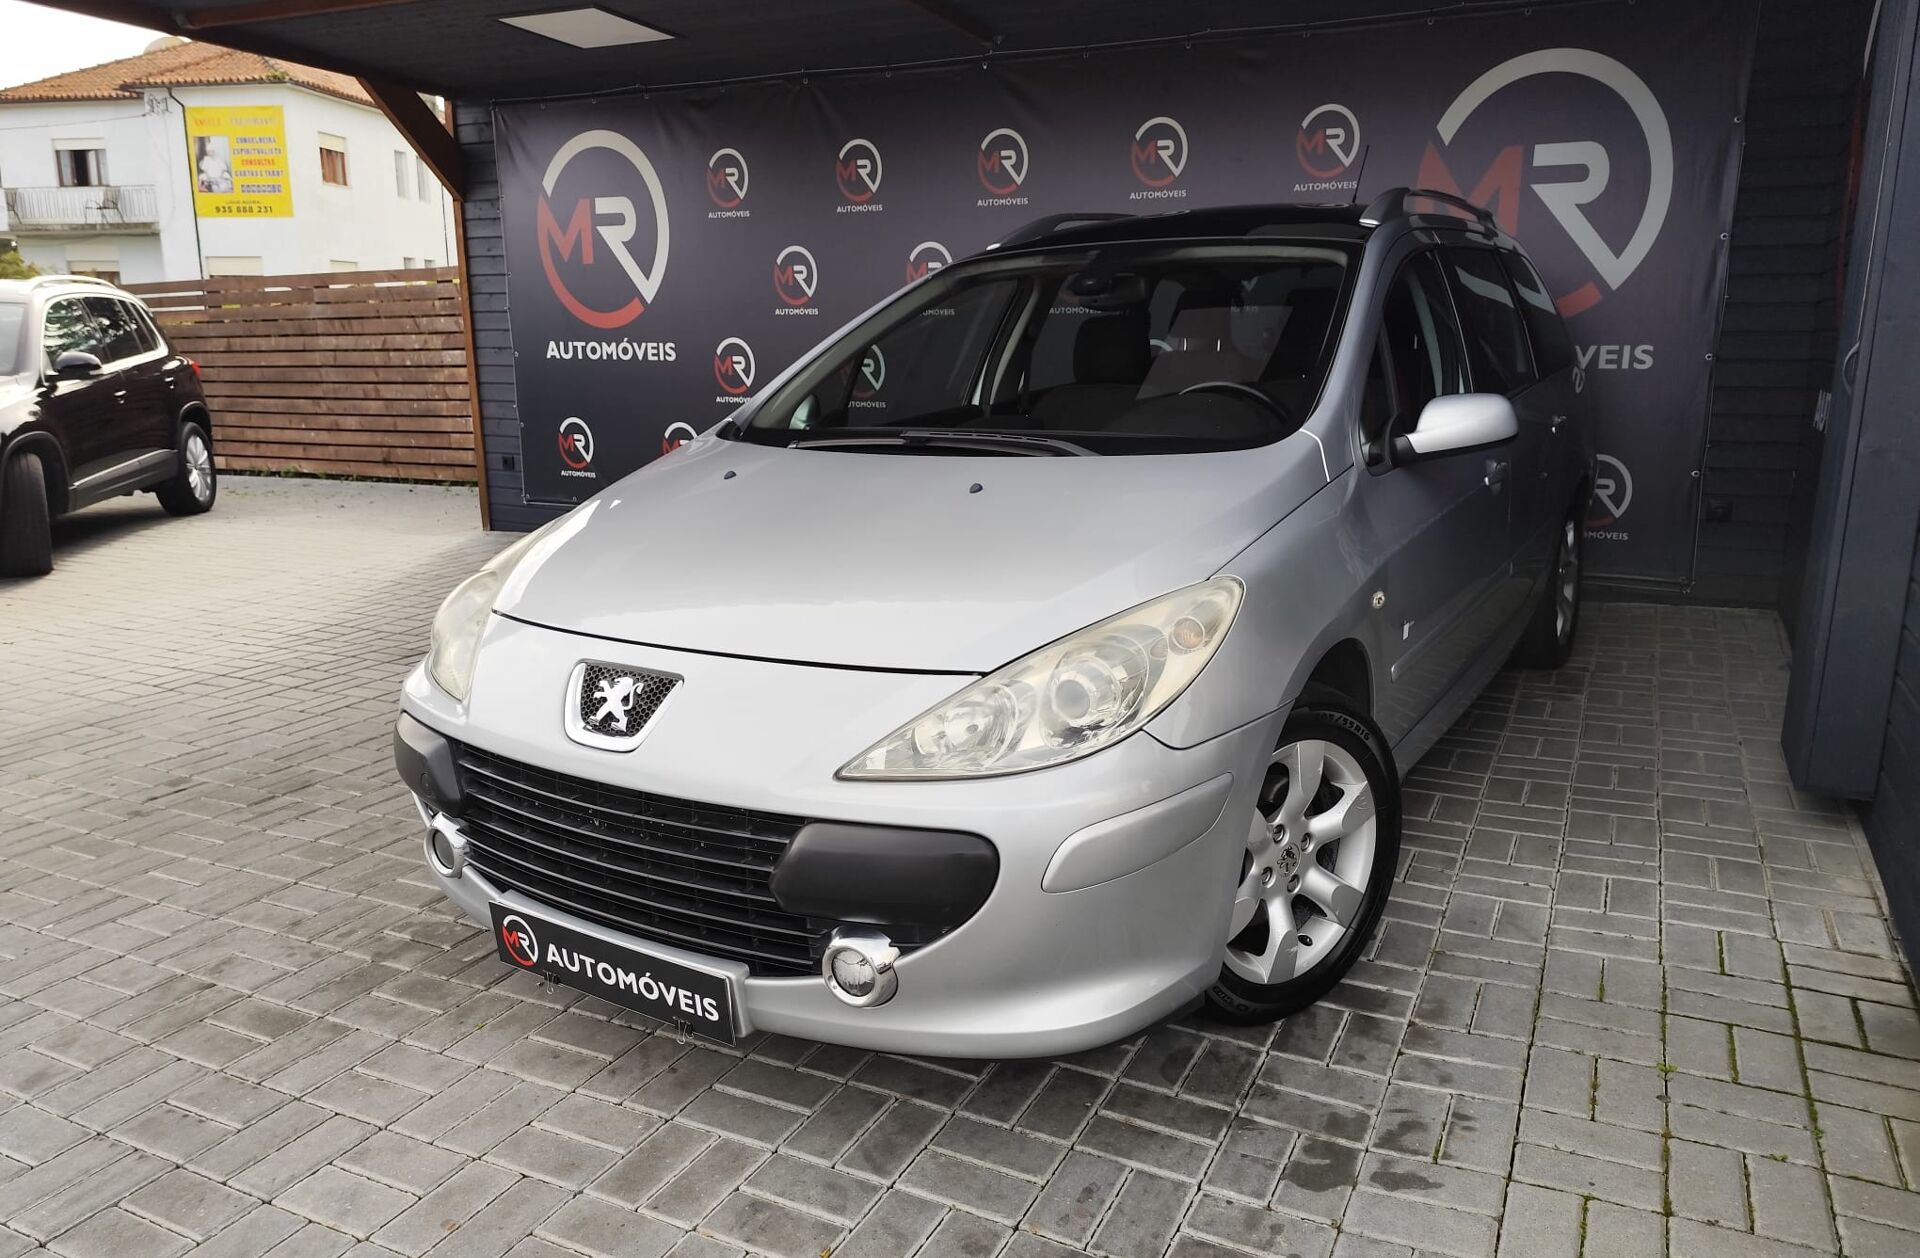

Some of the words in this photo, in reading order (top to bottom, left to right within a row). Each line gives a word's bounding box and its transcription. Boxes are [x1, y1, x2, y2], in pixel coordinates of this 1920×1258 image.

[1293, 181, 1358, 192] AUTOMÓVEIS
[1129, 189, 1187, 200] AUTOMÓVEIS
[977, 197, 1029, 207] AUTOMÓVEIS
[836, 204, 883, 213] AUTOMÓVEIS
[708, 210, 750, 218] AUTOMÓVEIS
[775, 307, 819, 316] AUTOMÓVEIS
[546, 337, 677, 362] AUTOMÓVEIS
[560, 469, 596, 478] AUTOMÓVEIS
[546, 942, 720, 1022] AUTOMÓVEIS
